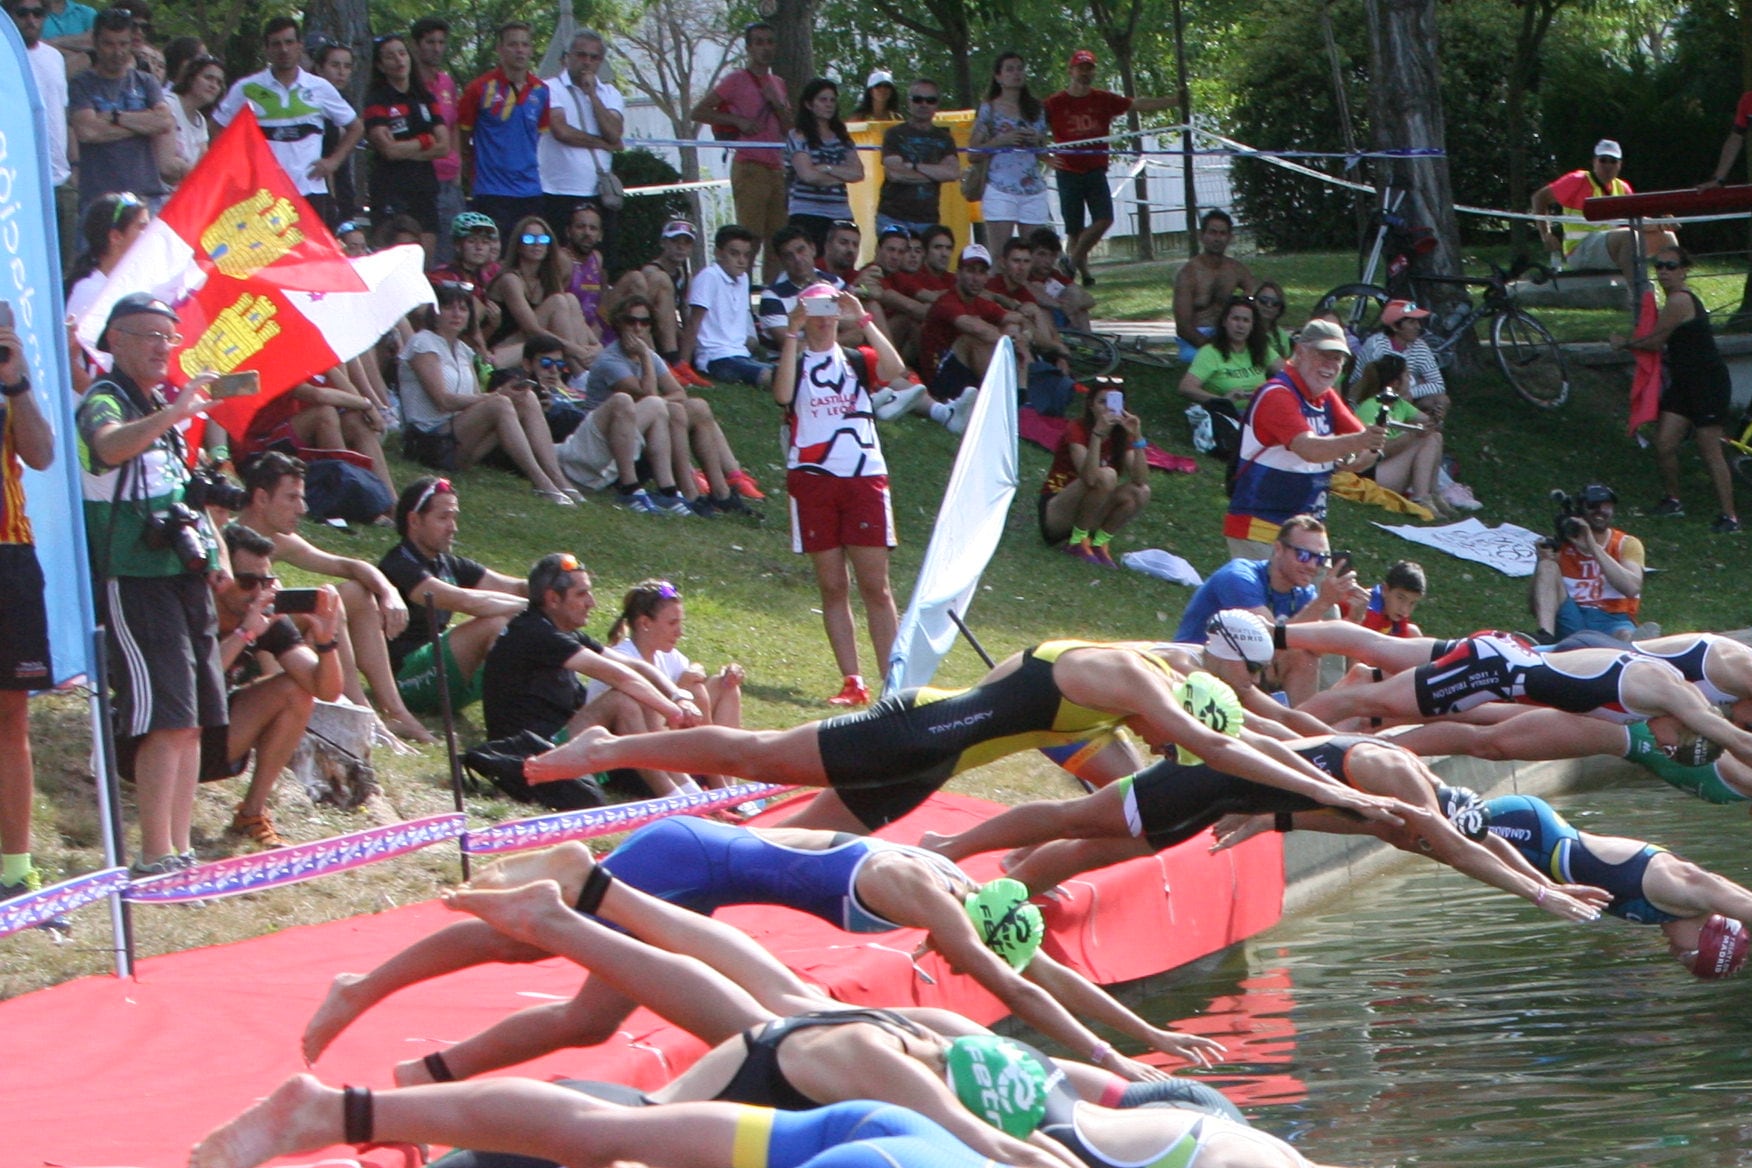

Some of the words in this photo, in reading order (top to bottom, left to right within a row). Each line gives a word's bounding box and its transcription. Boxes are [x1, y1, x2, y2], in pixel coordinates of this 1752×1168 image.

[810, 392, 858, 408] CASTILLA
[811, 409, 819, 419] Y
[1231, 633, 1263, 643] ADRID
[1432, 680, 1468, 700] TRIATLON
[1714, 935, 1731, 974] MADRID
